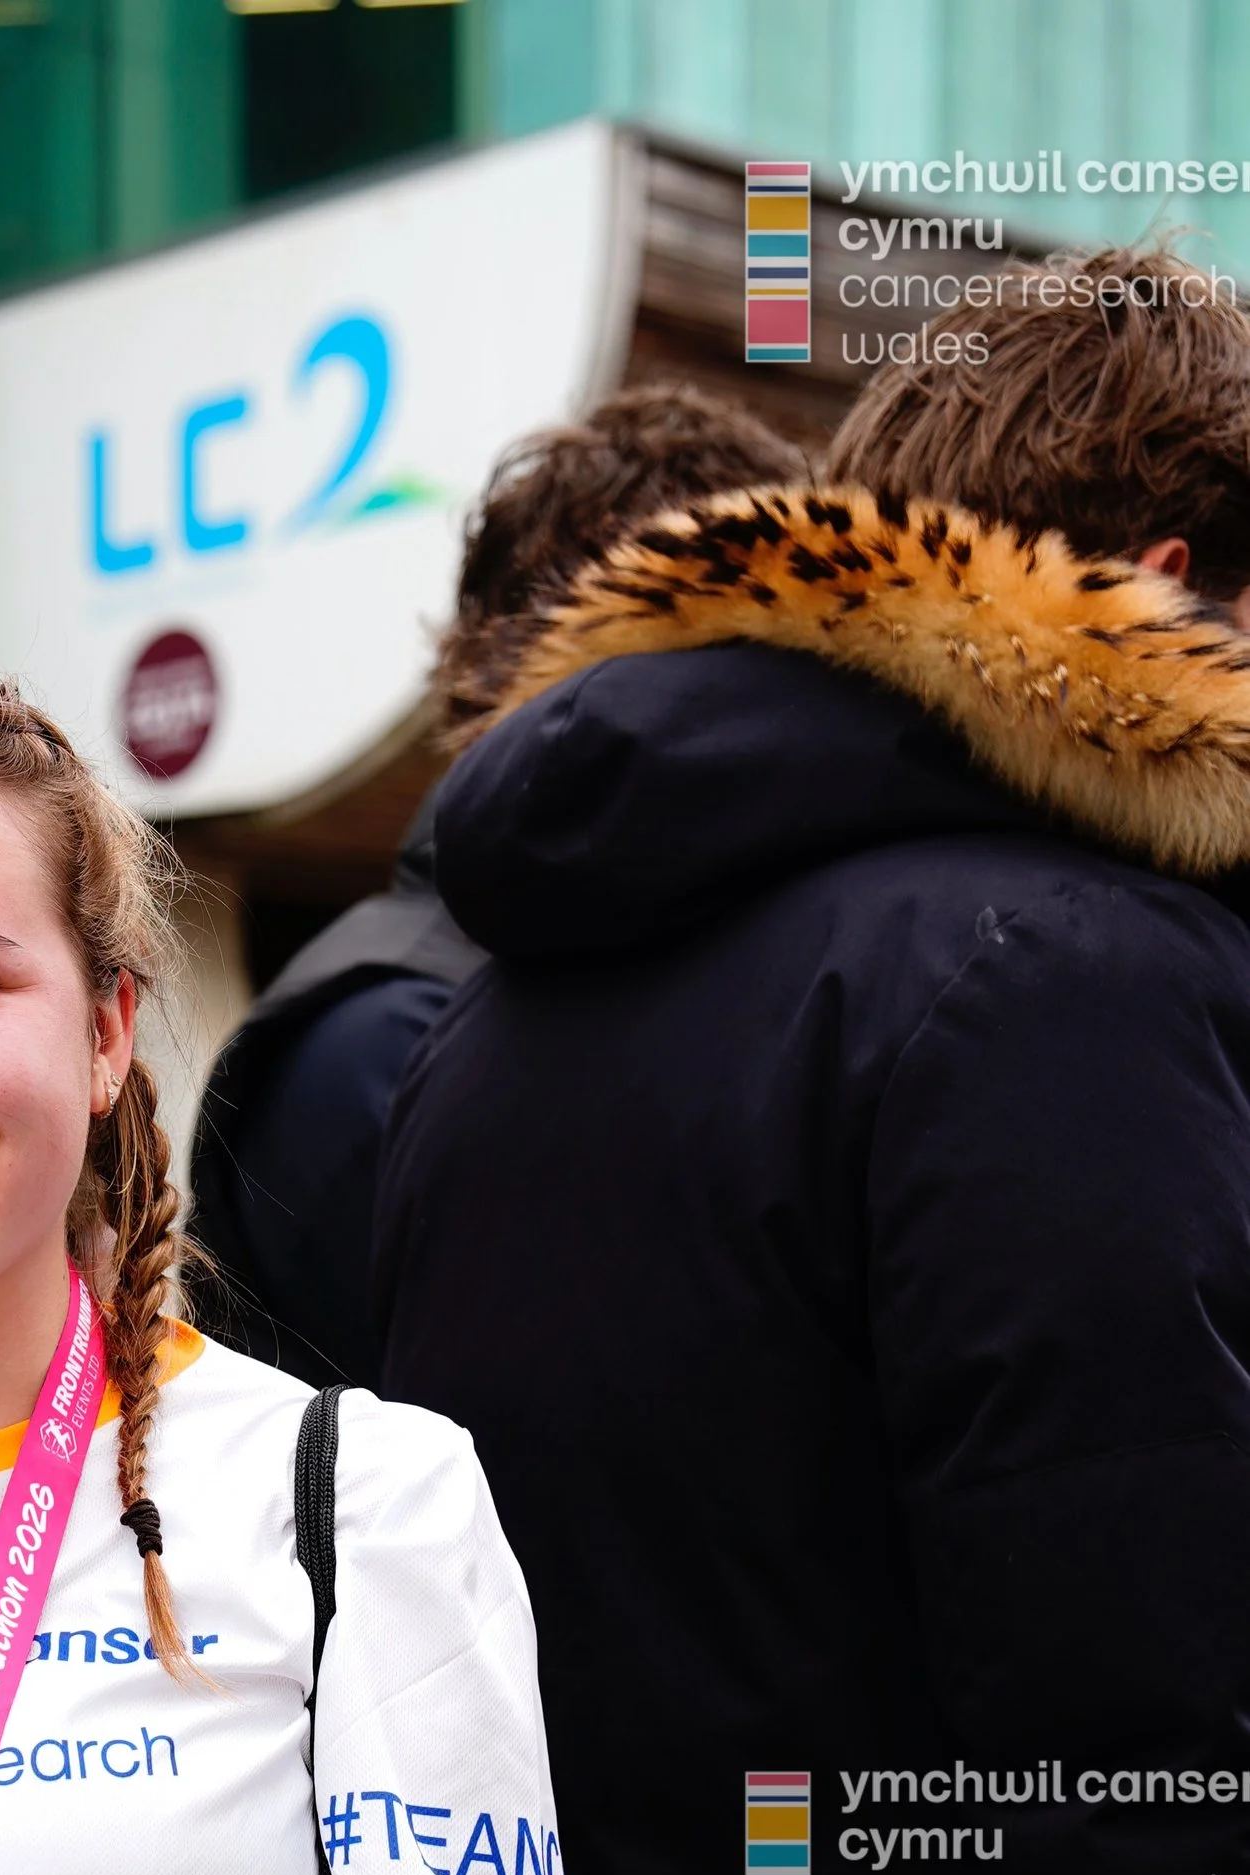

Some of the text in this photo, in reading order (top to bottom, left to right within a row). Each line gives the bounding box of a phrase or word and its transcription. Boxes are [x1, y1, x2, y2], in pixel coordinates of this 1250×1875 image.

[51, 1278, 92, 1417] FRONTRUNNER
[71, 1354, 100, 1430] EVENTS LTD
[8, 1482, 55, 1576] 2026
